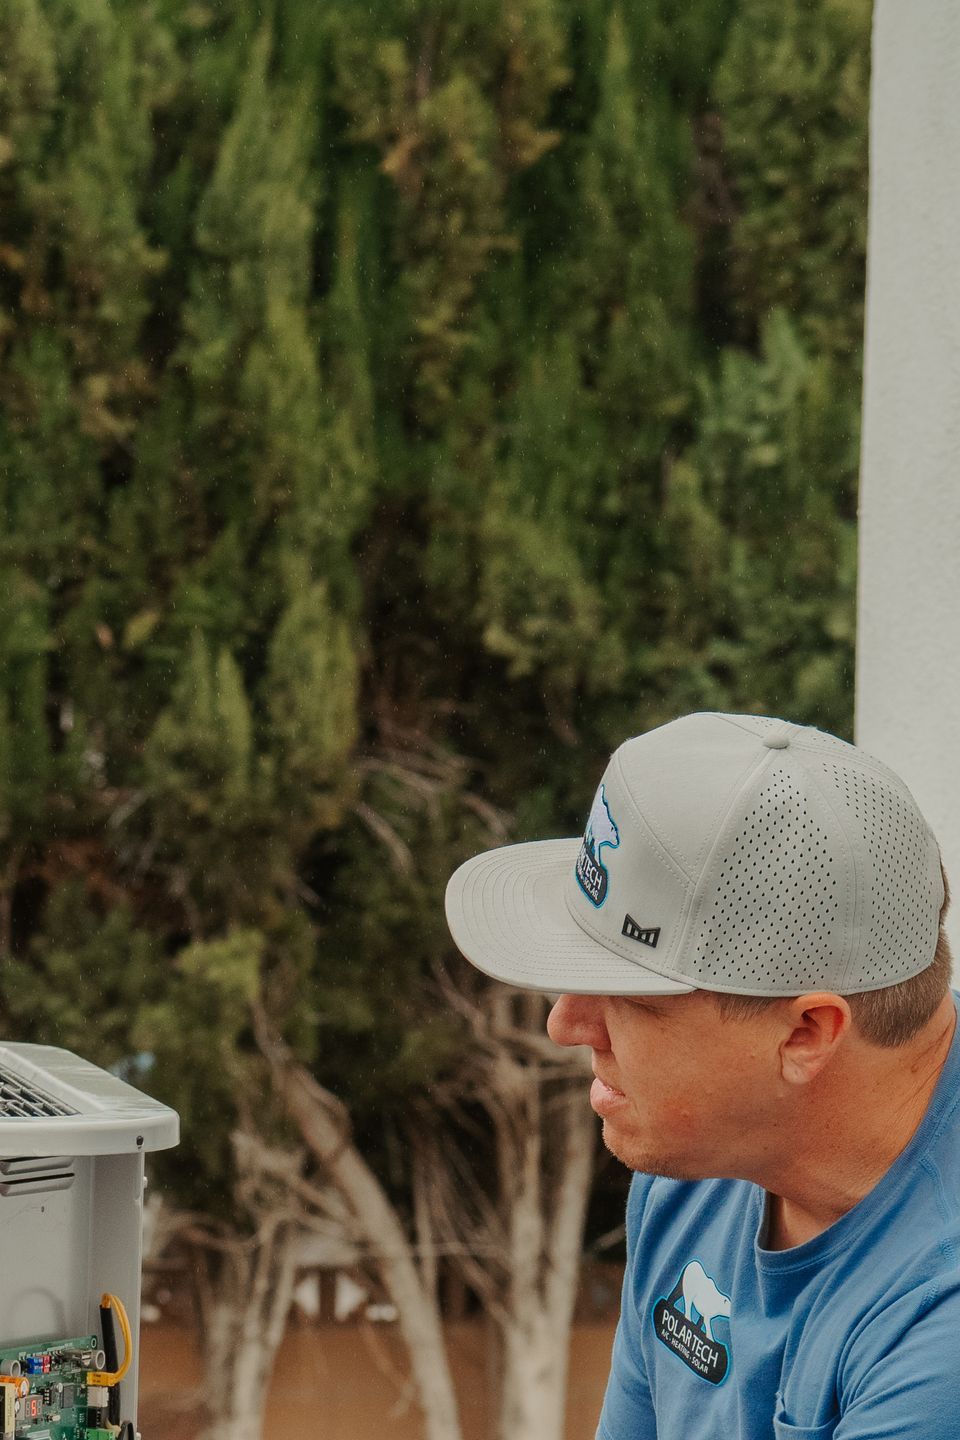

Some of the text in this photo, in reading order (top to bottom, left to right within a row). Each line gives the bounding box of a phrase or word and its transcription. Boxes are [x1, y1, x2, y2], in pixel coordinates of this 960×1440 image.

[661, 1309, 719, 1368] POLAR TECH
[671, 1338, 690, 1360] HEATING
[691, 1356, 709, 1374] SOLAR
